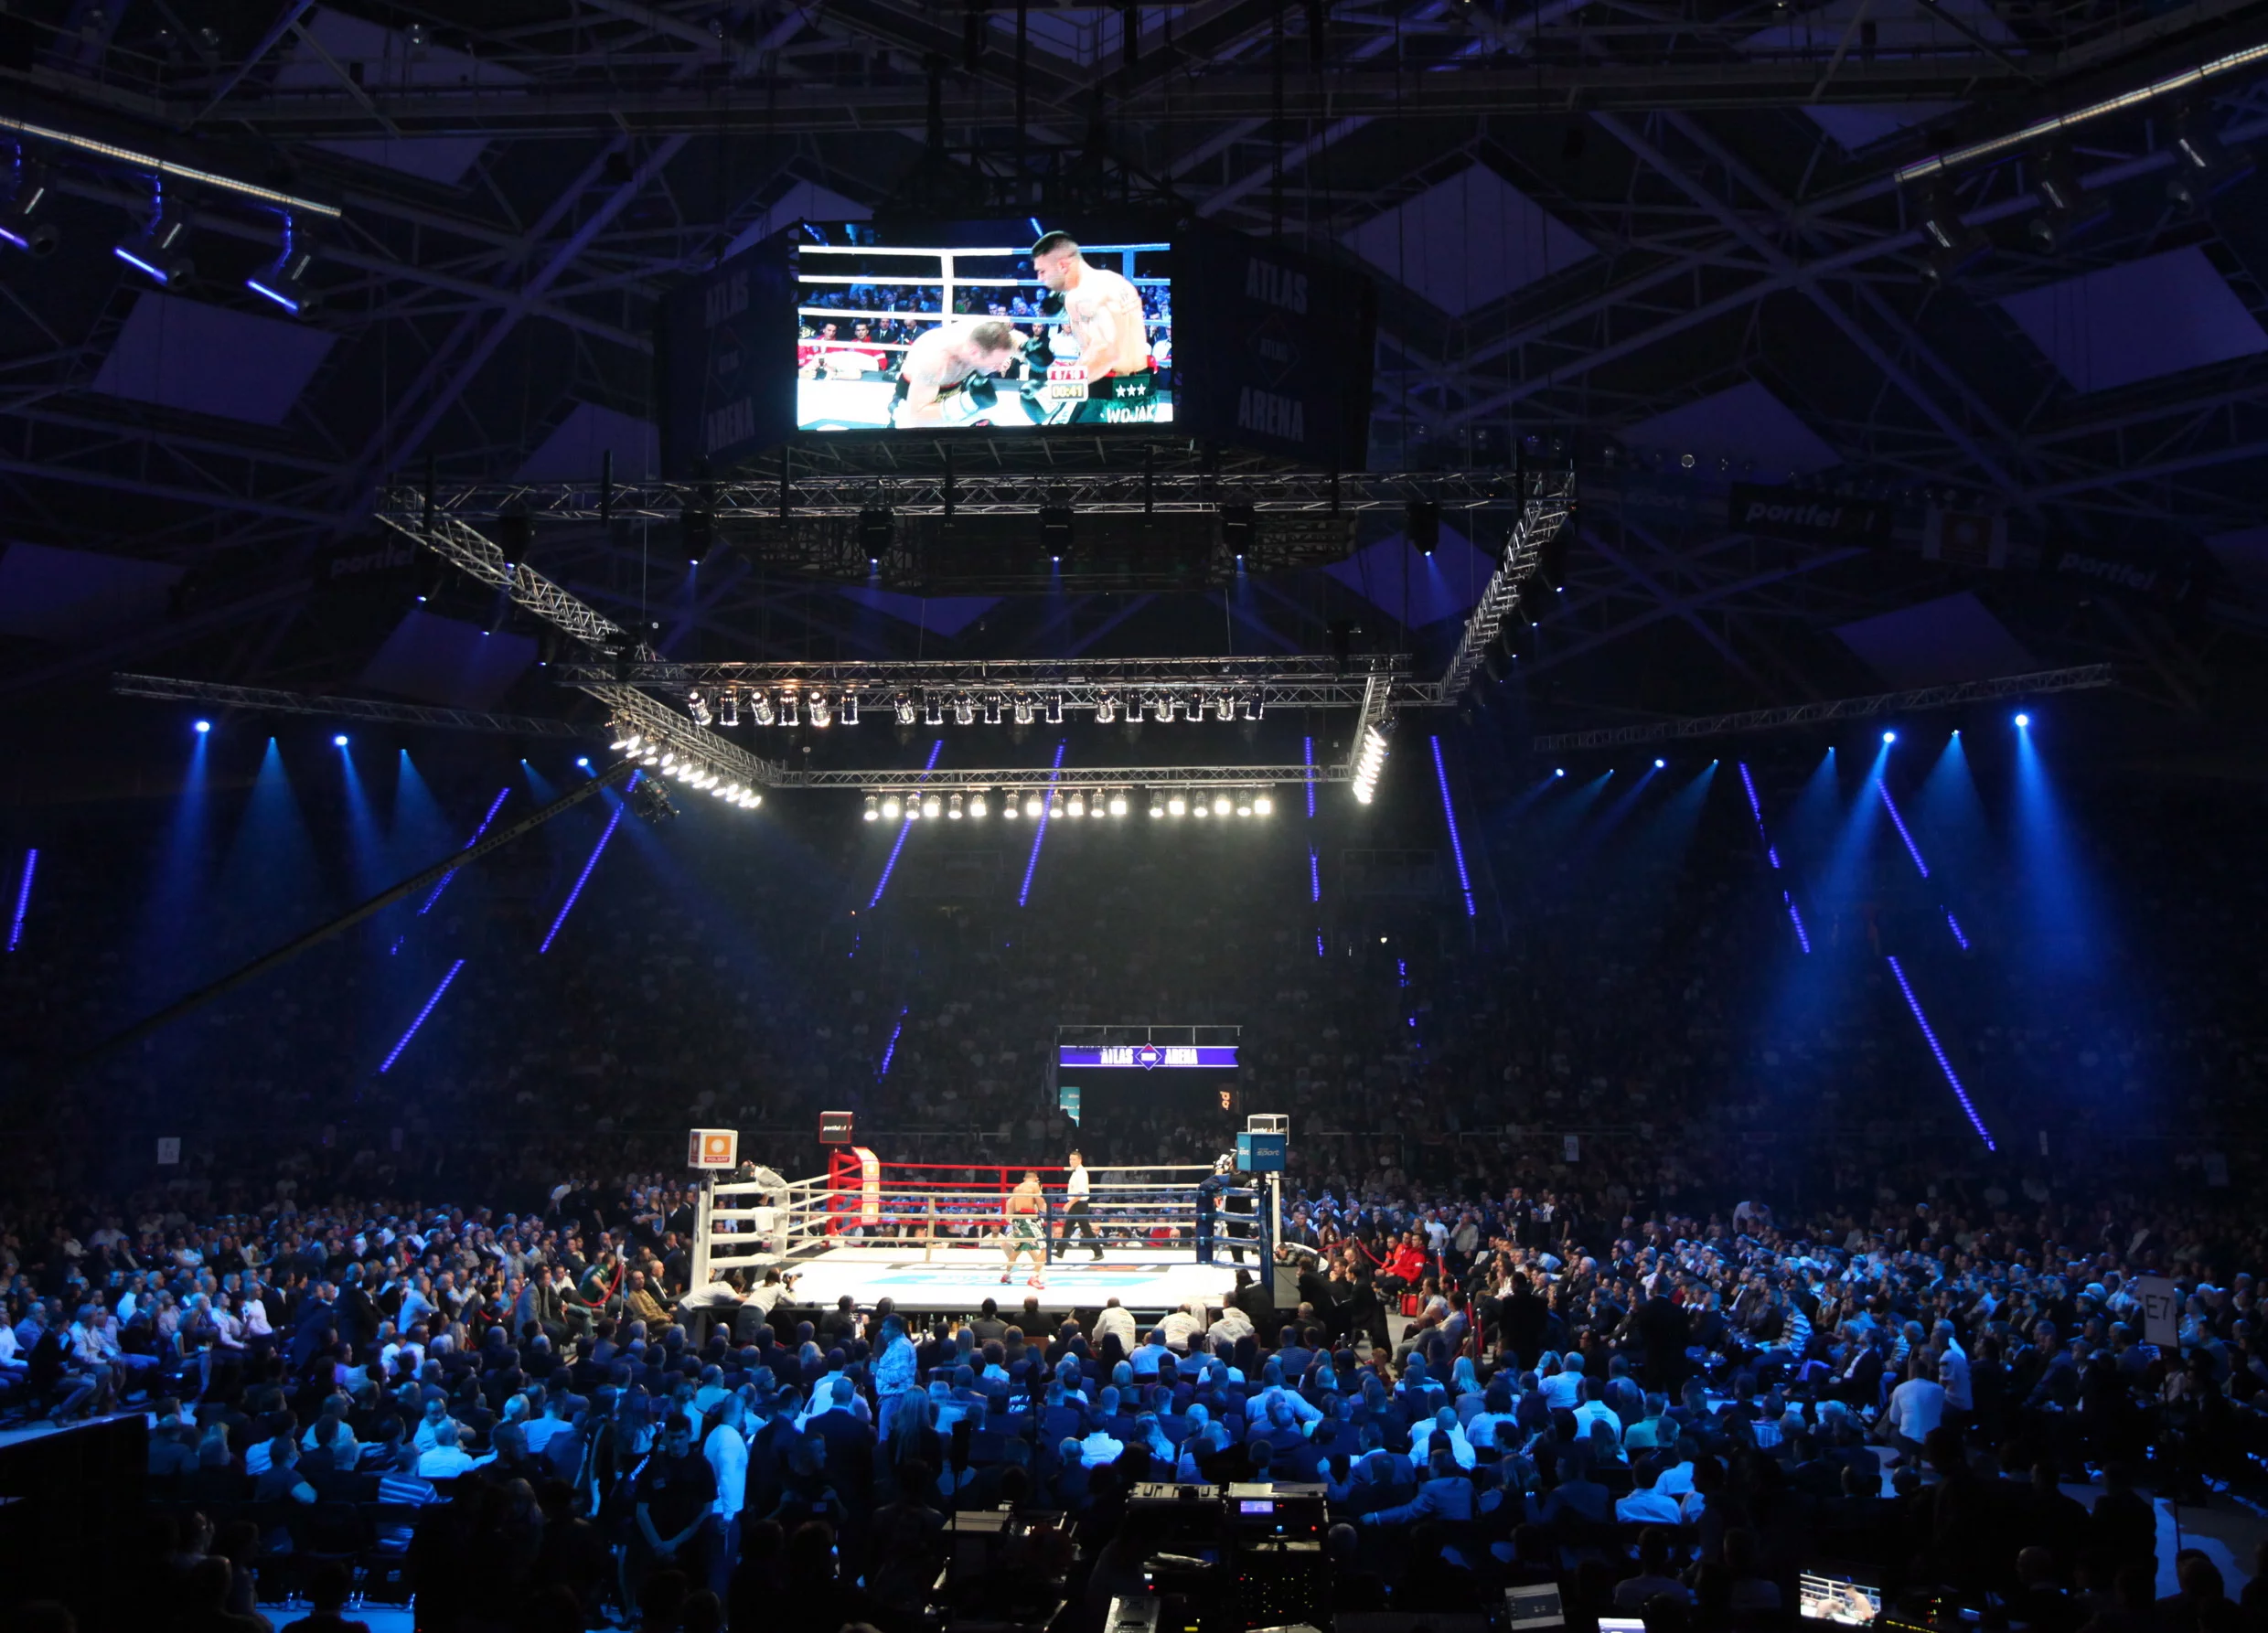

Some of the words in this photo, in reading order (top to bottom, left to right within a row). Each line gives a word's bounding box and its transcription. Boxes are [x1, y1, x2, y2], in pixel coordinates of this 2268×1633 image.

[1246, 257, 1308, 315] ATLAS
[1107, 404, 1156, 422] WOJAK
[1238, 386, 1304, 443] ARENA
[2145, 1295, 2169, 1320] E7
